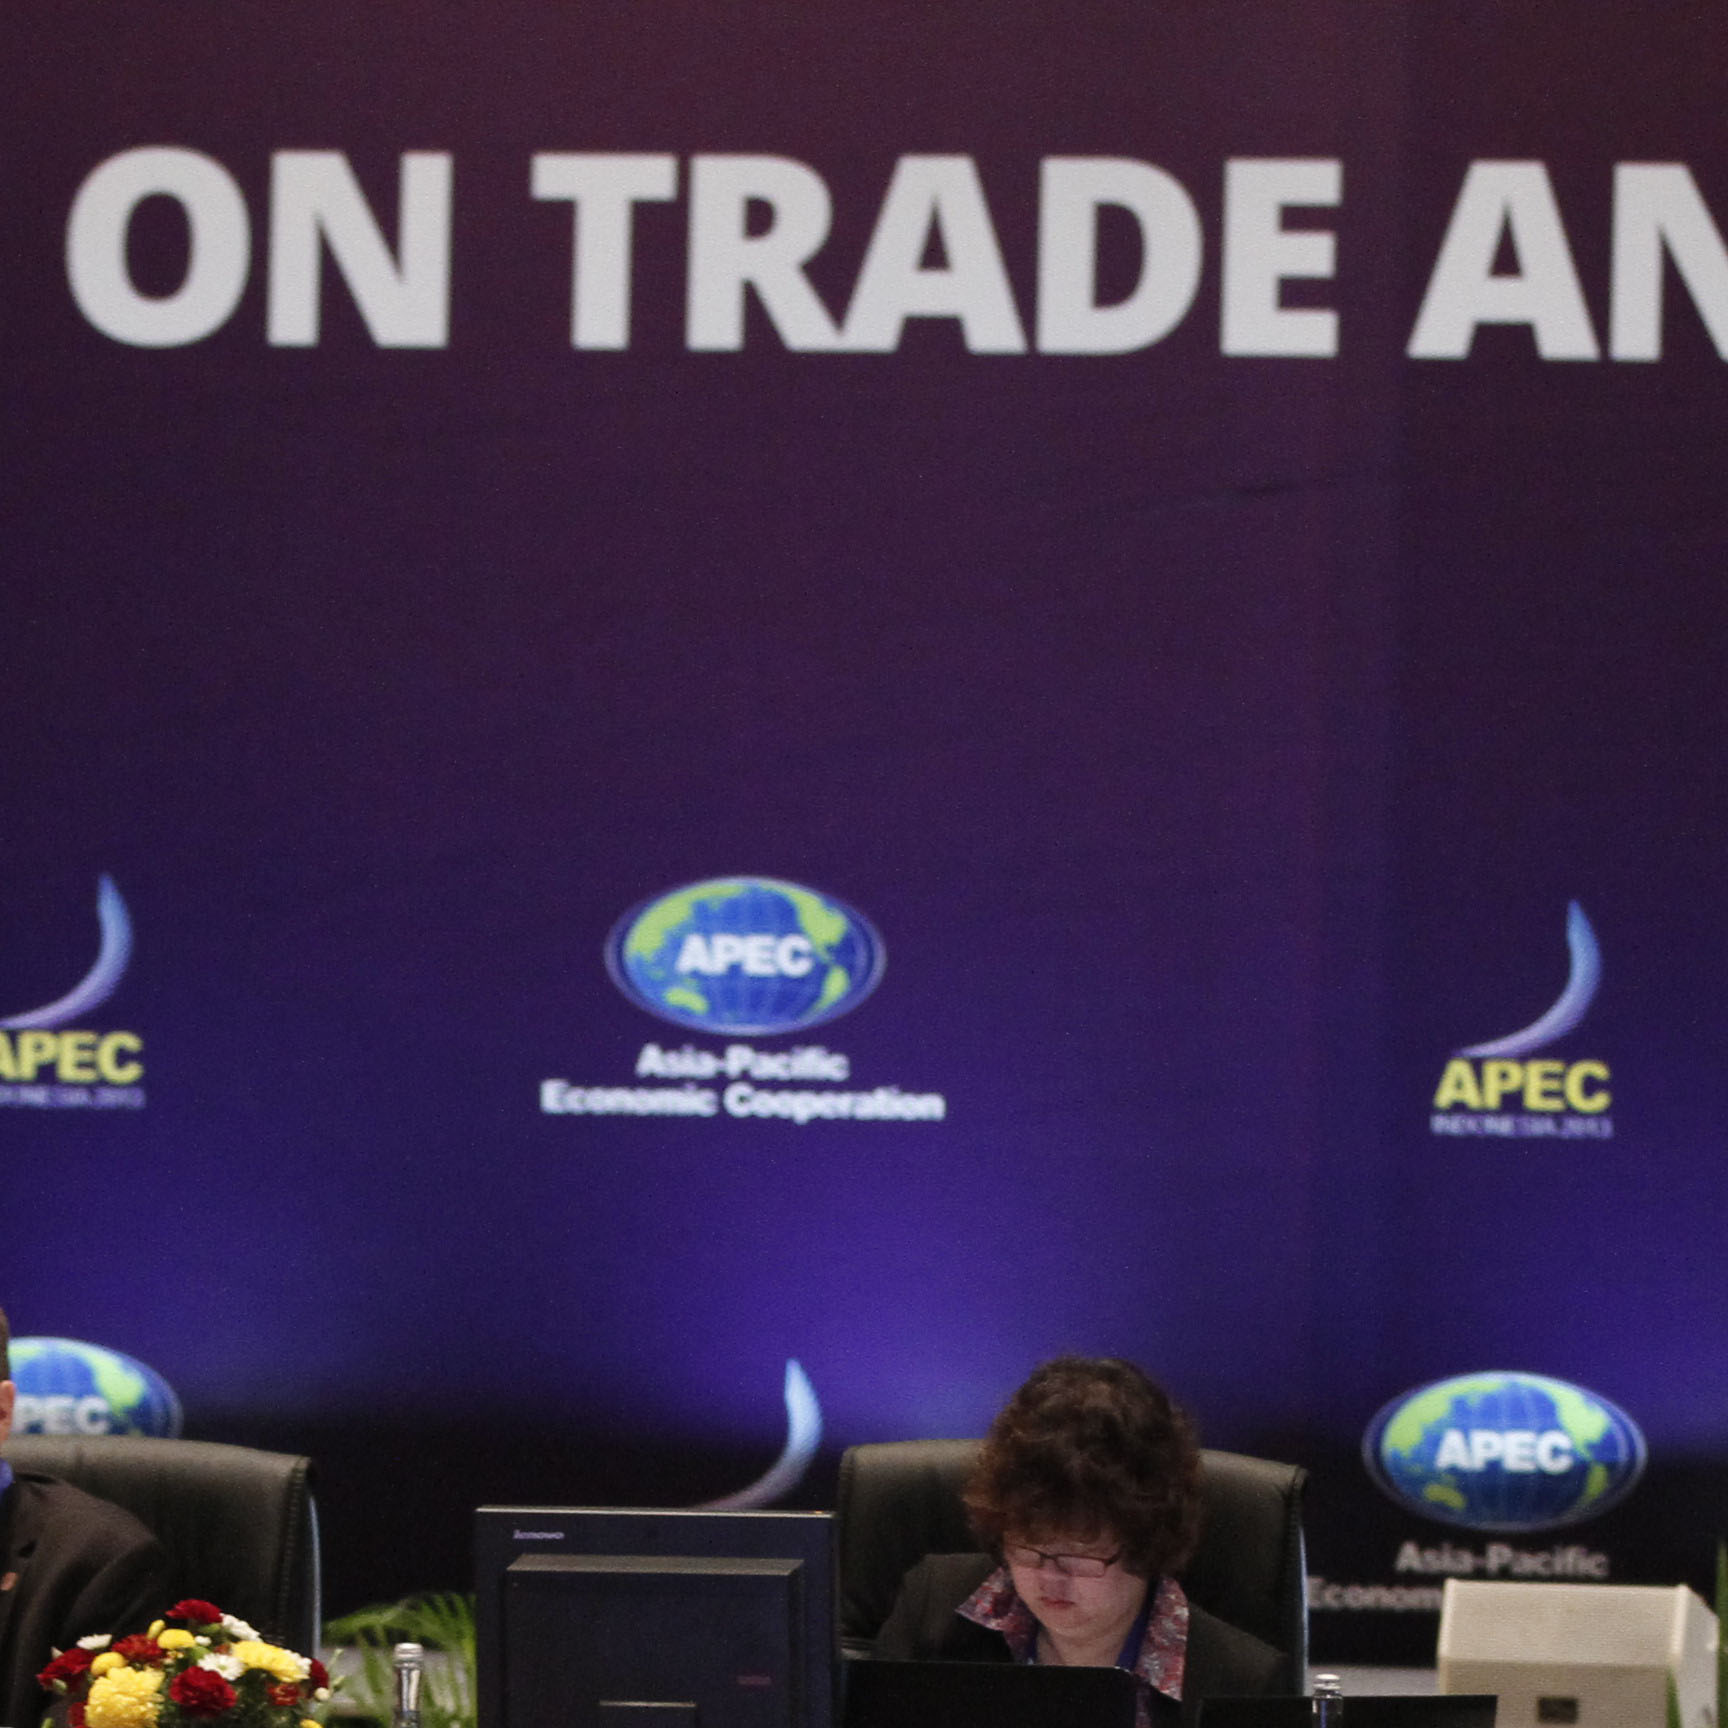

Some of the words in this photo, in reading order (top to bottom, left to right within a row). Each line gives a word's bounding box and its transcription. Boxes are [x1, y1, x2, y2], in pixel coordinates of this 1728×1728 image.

[65, 146, 453, 349] ON
[530, 152, 1343, 358] TRADE
[674, 933, 814, 978] APEC
[635, 1043, 851, 1082] Asia-Pacific
[1433, 1057, 1613, 1114] APEC
[540, 1078, 719, 1116] Economic
[723, 1081, 947, 1126] Cooperation
[10, 1394, 110, 1435] PEC
[1434, 1428, 1574, 1475] APEC
[1394, 1541, 1609, 1577] Asia-Pacific
